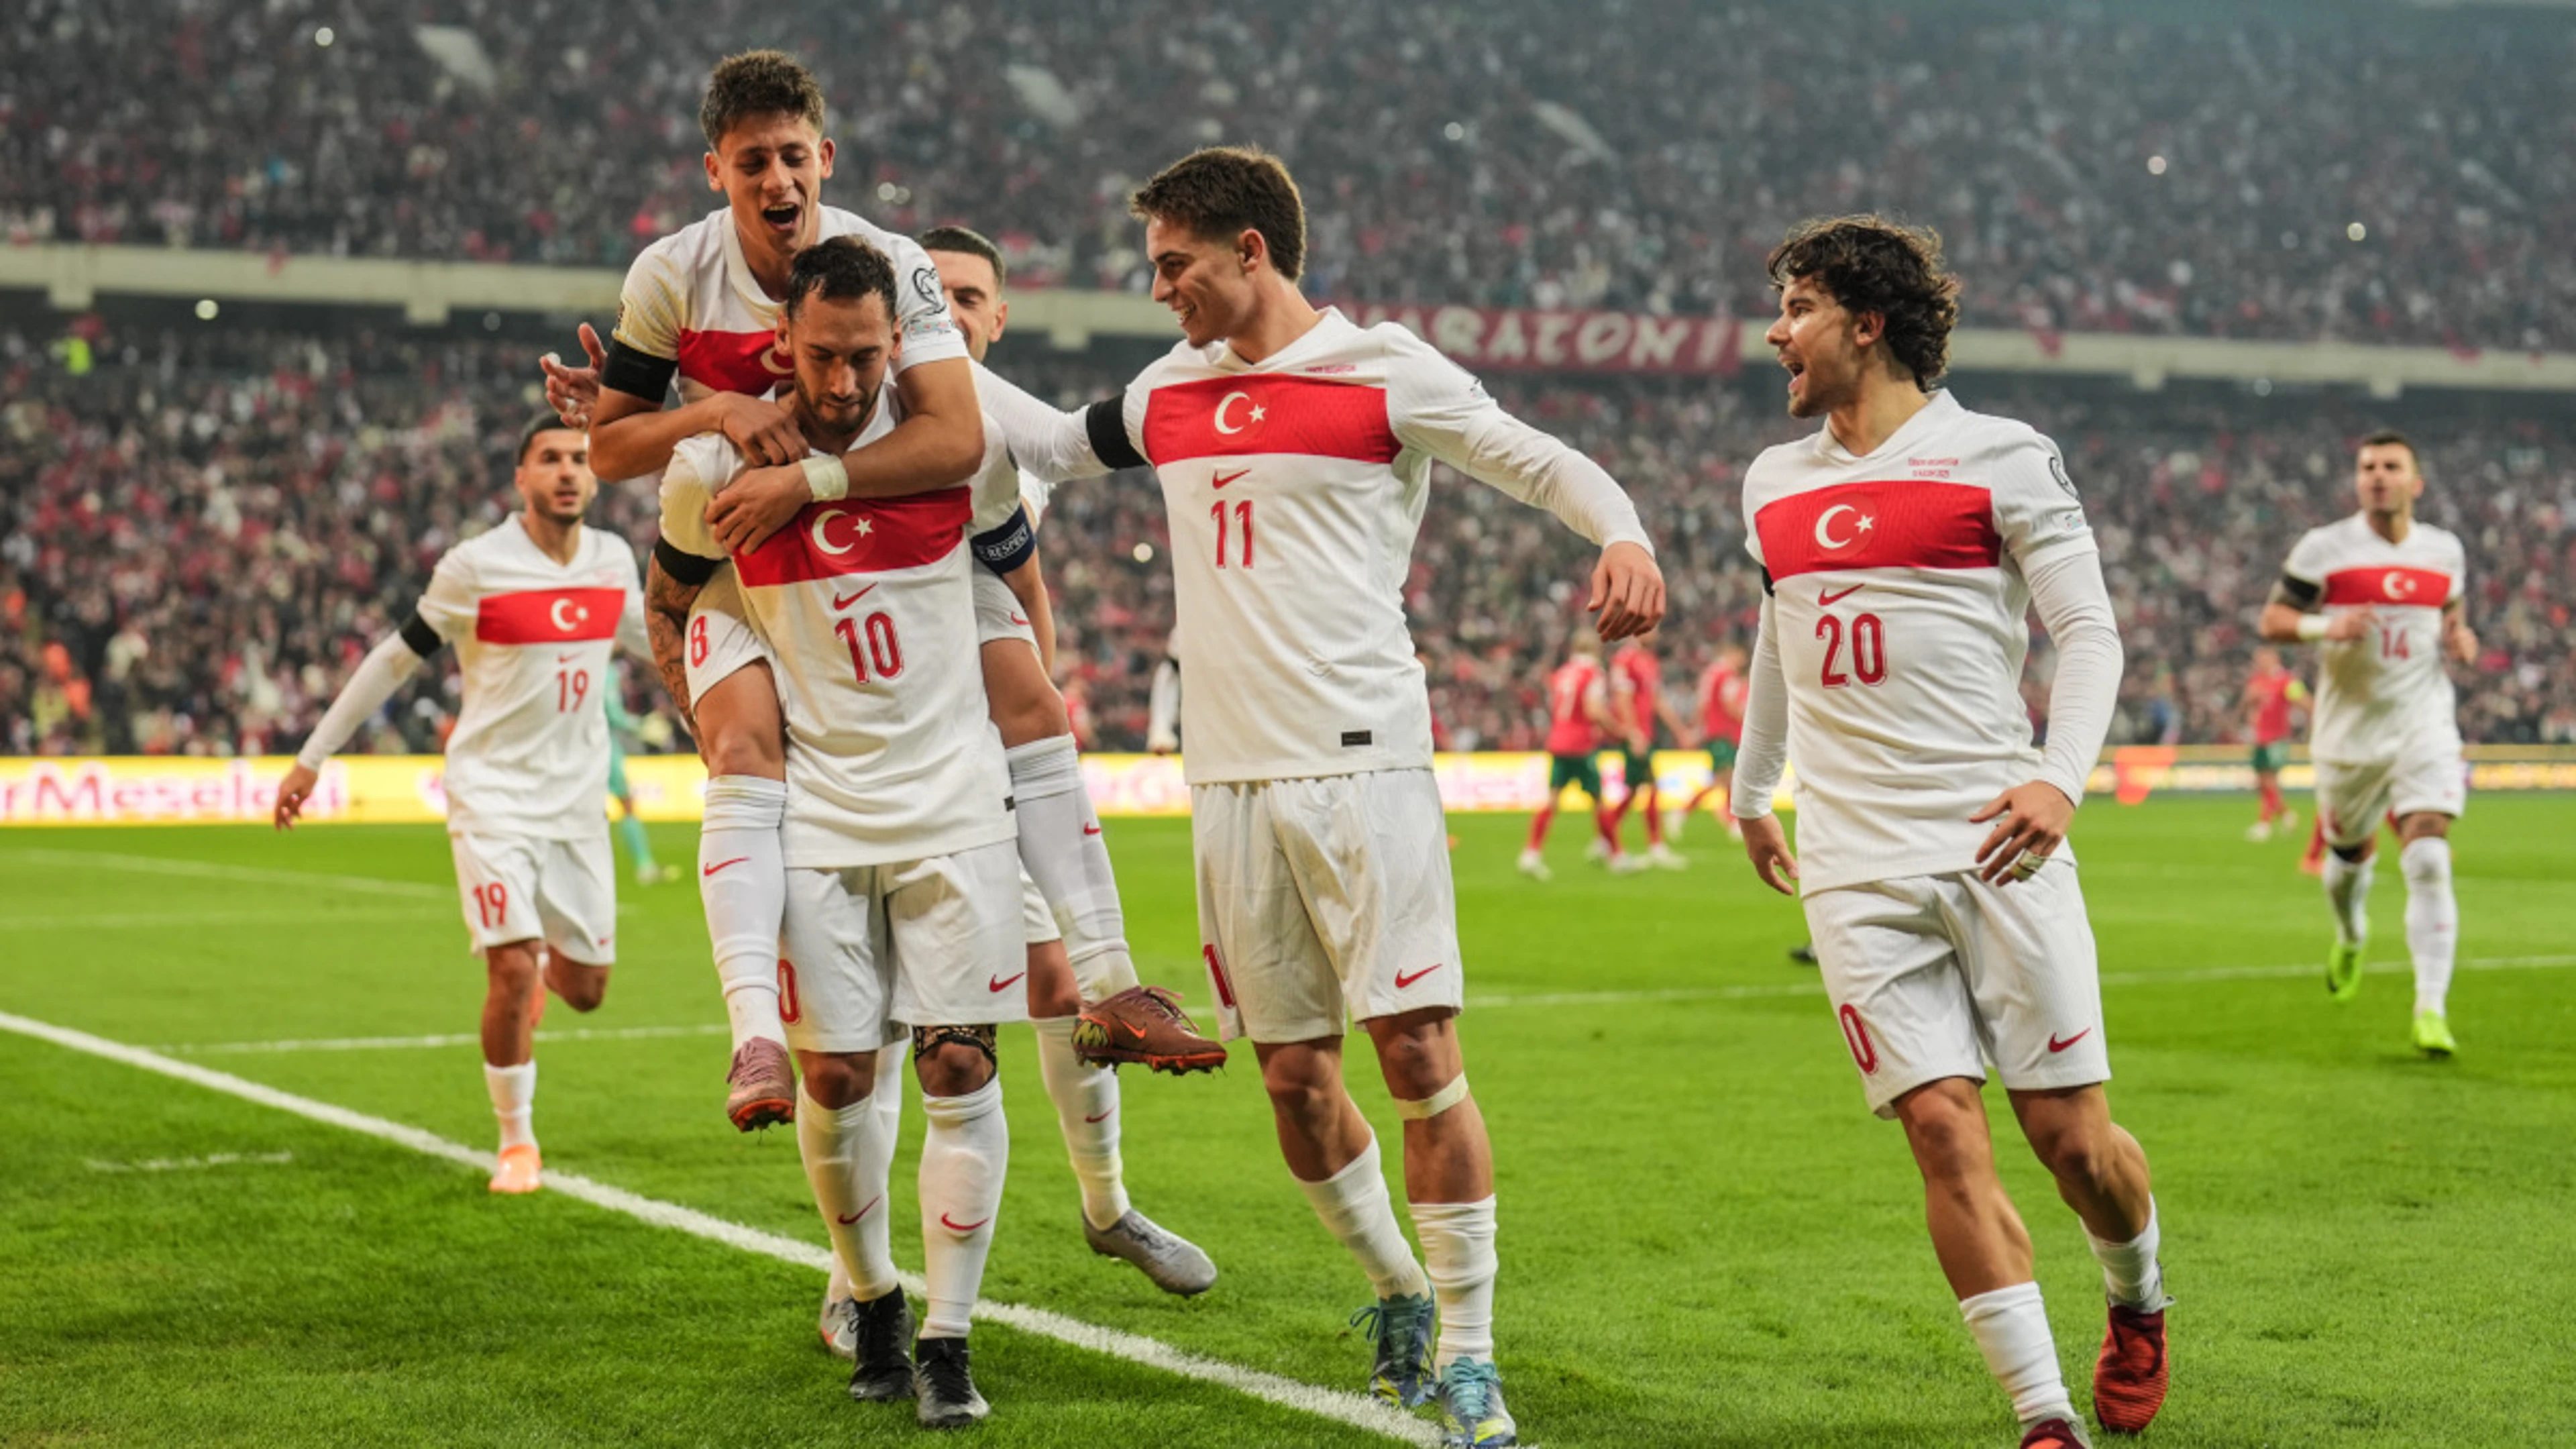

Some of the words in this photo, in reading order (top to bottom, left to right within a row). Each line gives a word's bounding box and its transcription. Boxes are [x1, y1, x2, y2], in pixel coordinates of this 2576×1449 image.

[1211, 500, 1254, 569] 11
[691, 616, 709, 667] 8
[835, 612, 904, 684] 10
[1816, 613, 1888, 688] 20
[2382, 627, 2410, 660] 14
[556, 669, 589, 714] 19
[473, 882, 506, 929] 19
[777, 959, 801, 1026] 0
[1839, 1002, 1879, 1075] 0
